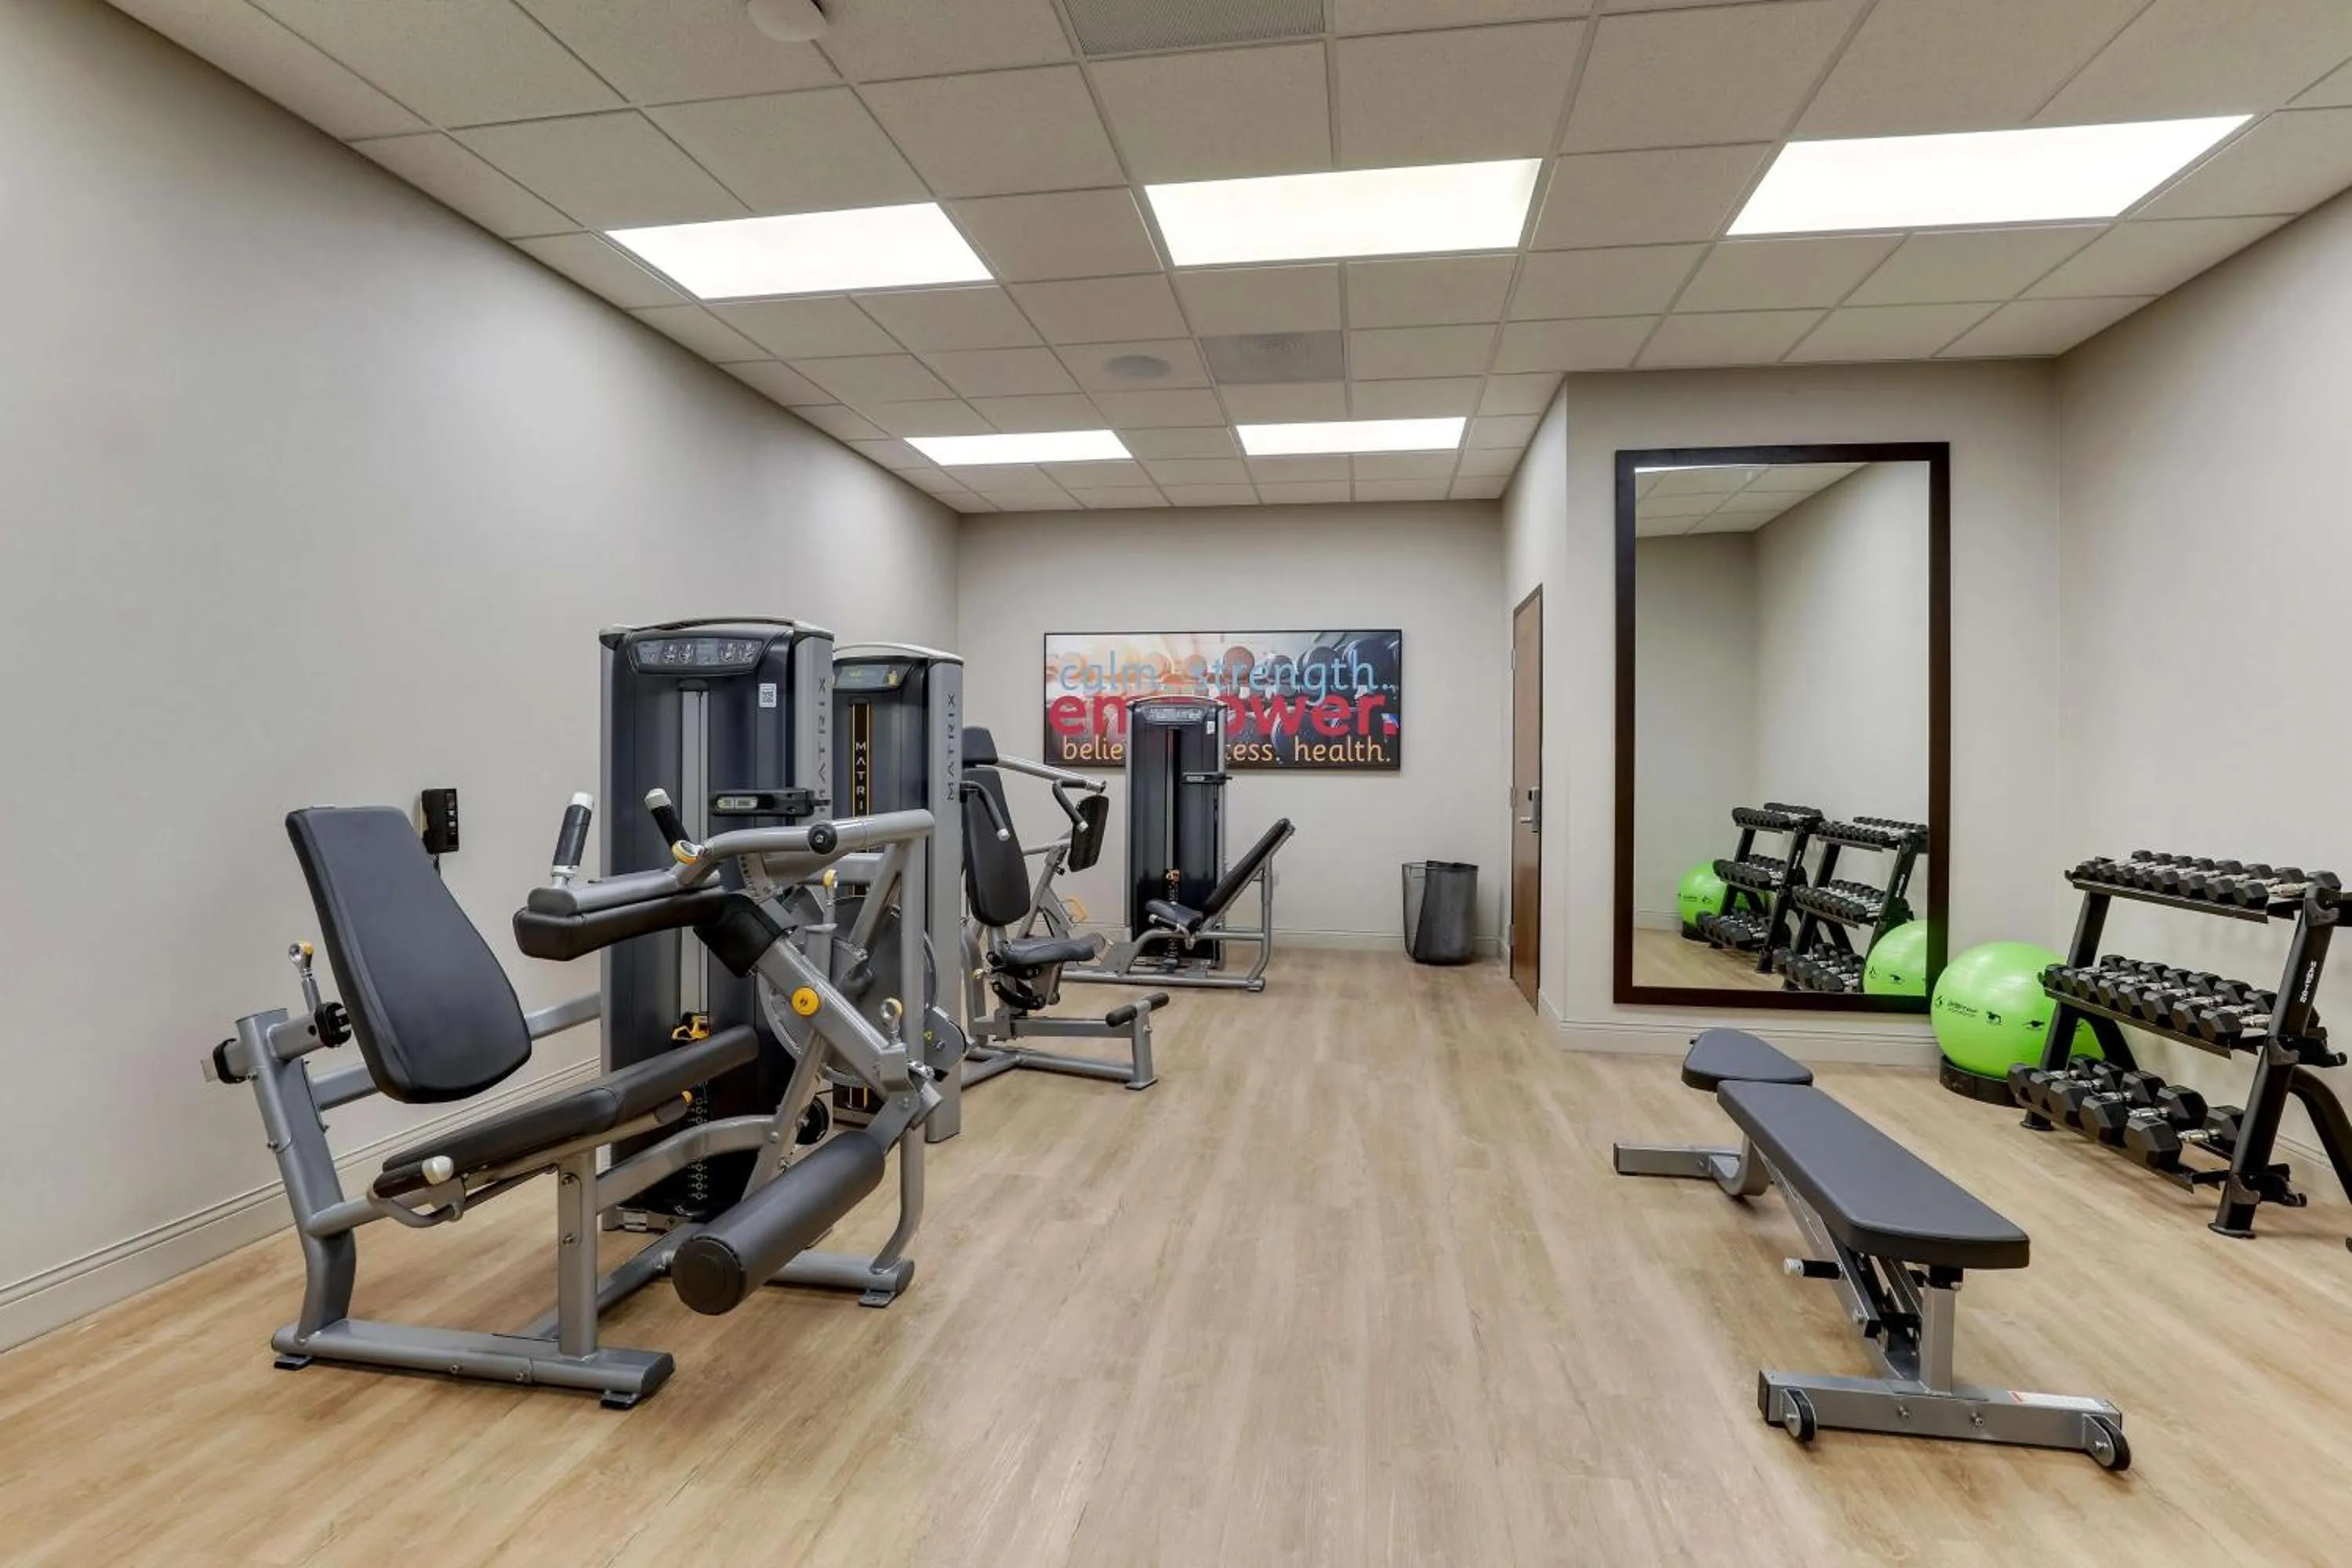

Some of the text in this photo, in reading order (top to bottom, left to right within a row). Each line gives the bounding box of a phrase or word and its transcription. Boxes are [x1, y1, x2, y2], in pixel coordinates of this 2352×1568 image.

[1191, 648, 1388, 706] strength.
[855, 741, 867, 810] MATRI
[1062, 732, 1127, 760] belie
[1294, 734, 1392, 762] health.
